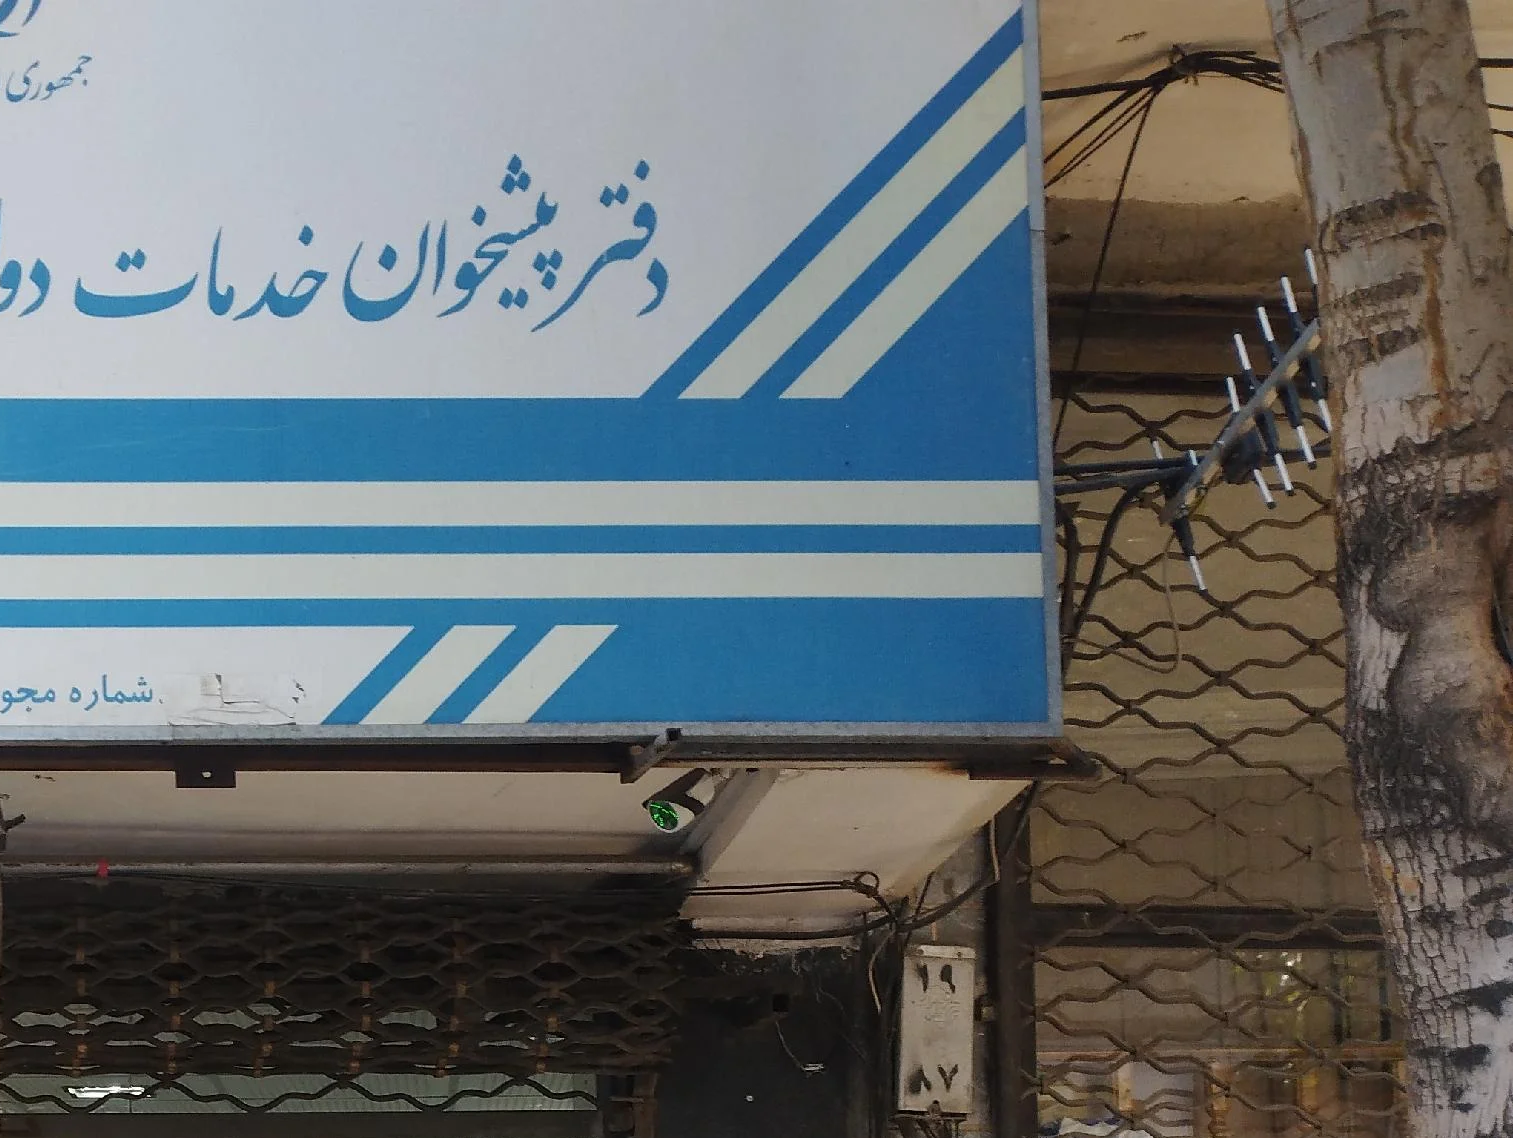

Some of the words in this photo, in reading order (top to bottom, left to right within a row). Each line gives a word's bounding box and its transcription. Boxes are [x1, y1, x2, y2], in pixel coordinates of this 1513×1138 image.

[5, 55, 93, 103] جمهوری
[74, 223, 330, 322] خدمات
[341, 153, 559, 323] پیشخوان
[531, 158, 669, 333] دفتر
[68, 674, 155, 713] شماره
